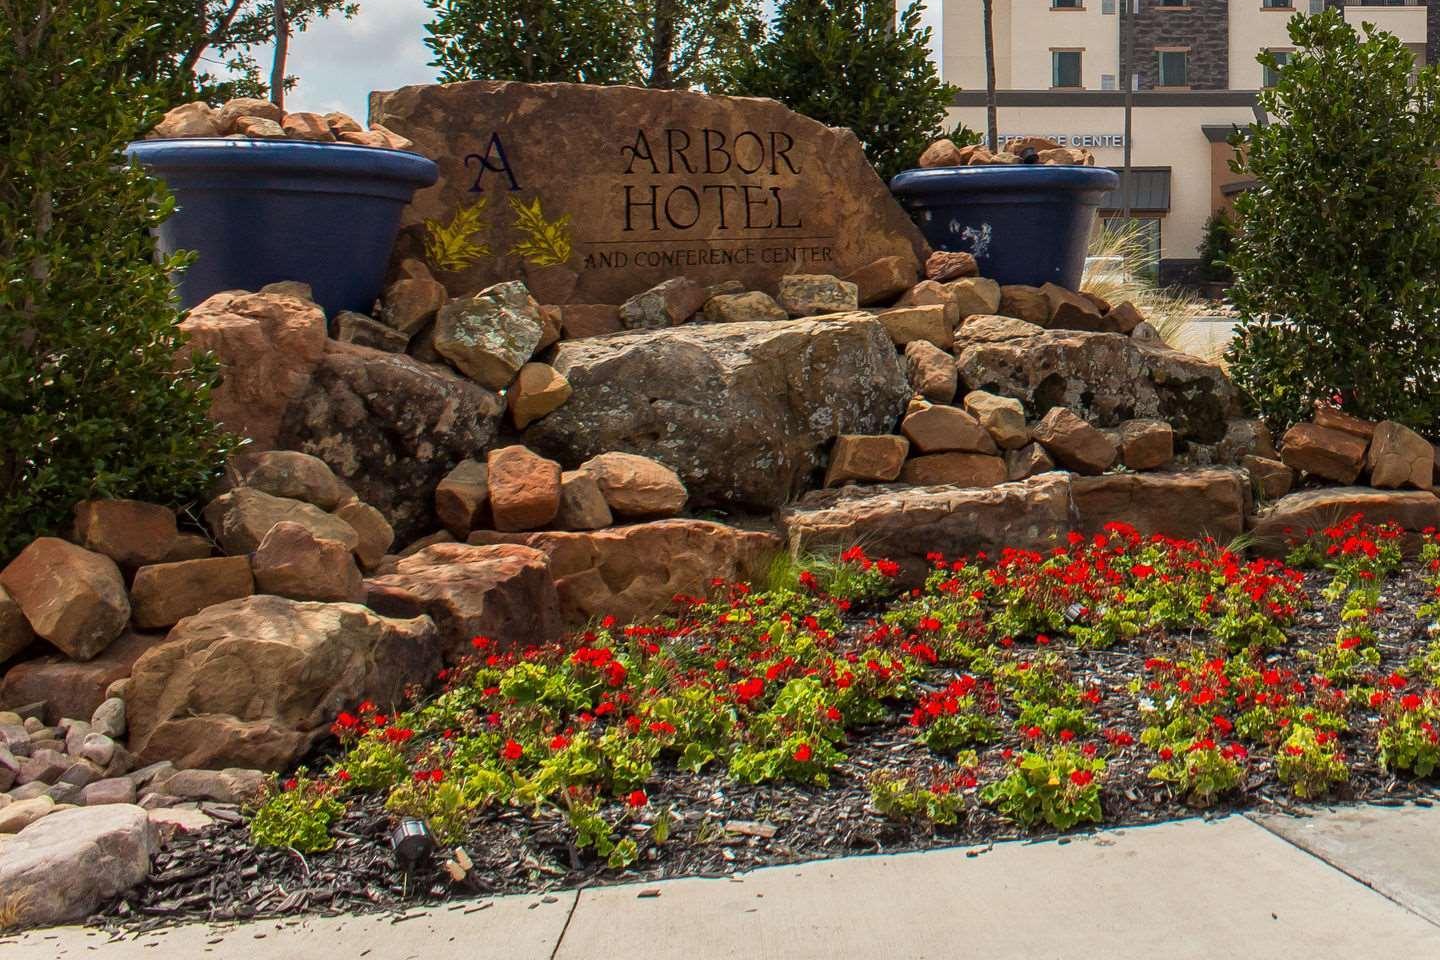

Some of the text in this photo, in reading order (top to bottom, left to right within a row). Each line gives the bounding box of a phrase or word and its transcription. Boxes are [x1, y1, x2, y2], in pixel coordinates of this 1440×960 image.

[465, 132, 522, 193] A
[620, 129, 801, 176] ARBOR
[1071, 135, 1126, 147] CENTE
[622, 184, 802, 232] HOTEL
[584, 246, 833, 270] AND CONFERENCE CENTER
